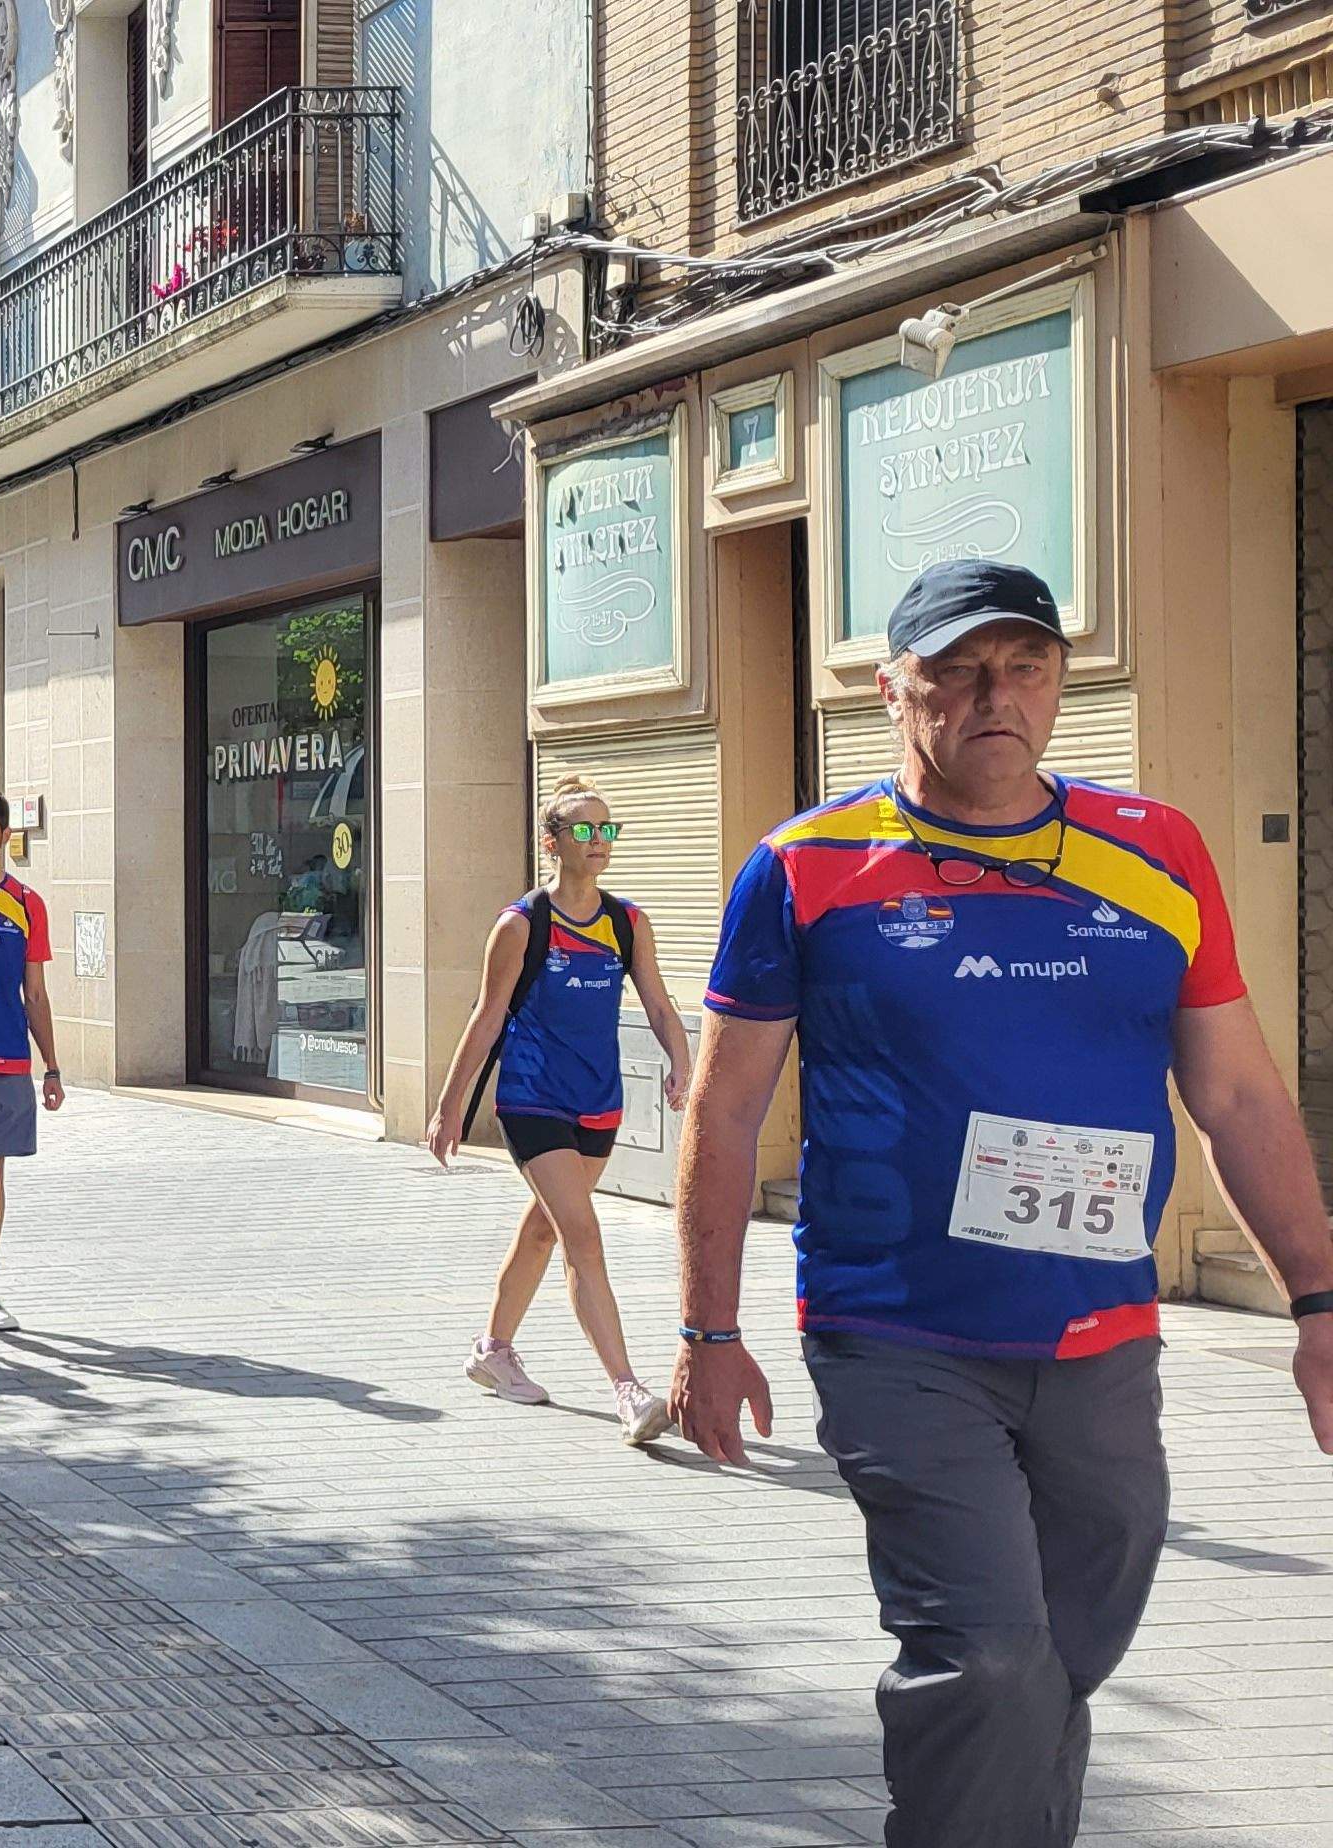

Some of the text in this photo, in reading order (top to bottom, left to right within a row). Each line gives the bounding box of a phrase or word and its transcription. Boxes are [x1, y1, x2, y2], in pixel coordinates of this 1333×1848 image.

[743, 415, 759, 457] 7
[128, 489, 349, 582] CMC MODA HOGAR
[214, 730, 344, 781] PRIMAVERA
[335, 831, 350, 859] 30
[1067, 923, 1149, 942] Santander
[1010, 955, 1089, 982] mupol
[584, 977, 611, 990] mupol
[307, 1034, 359, 1055] @cmchuesca
[1003, 1184, 1116, 1235] 315
